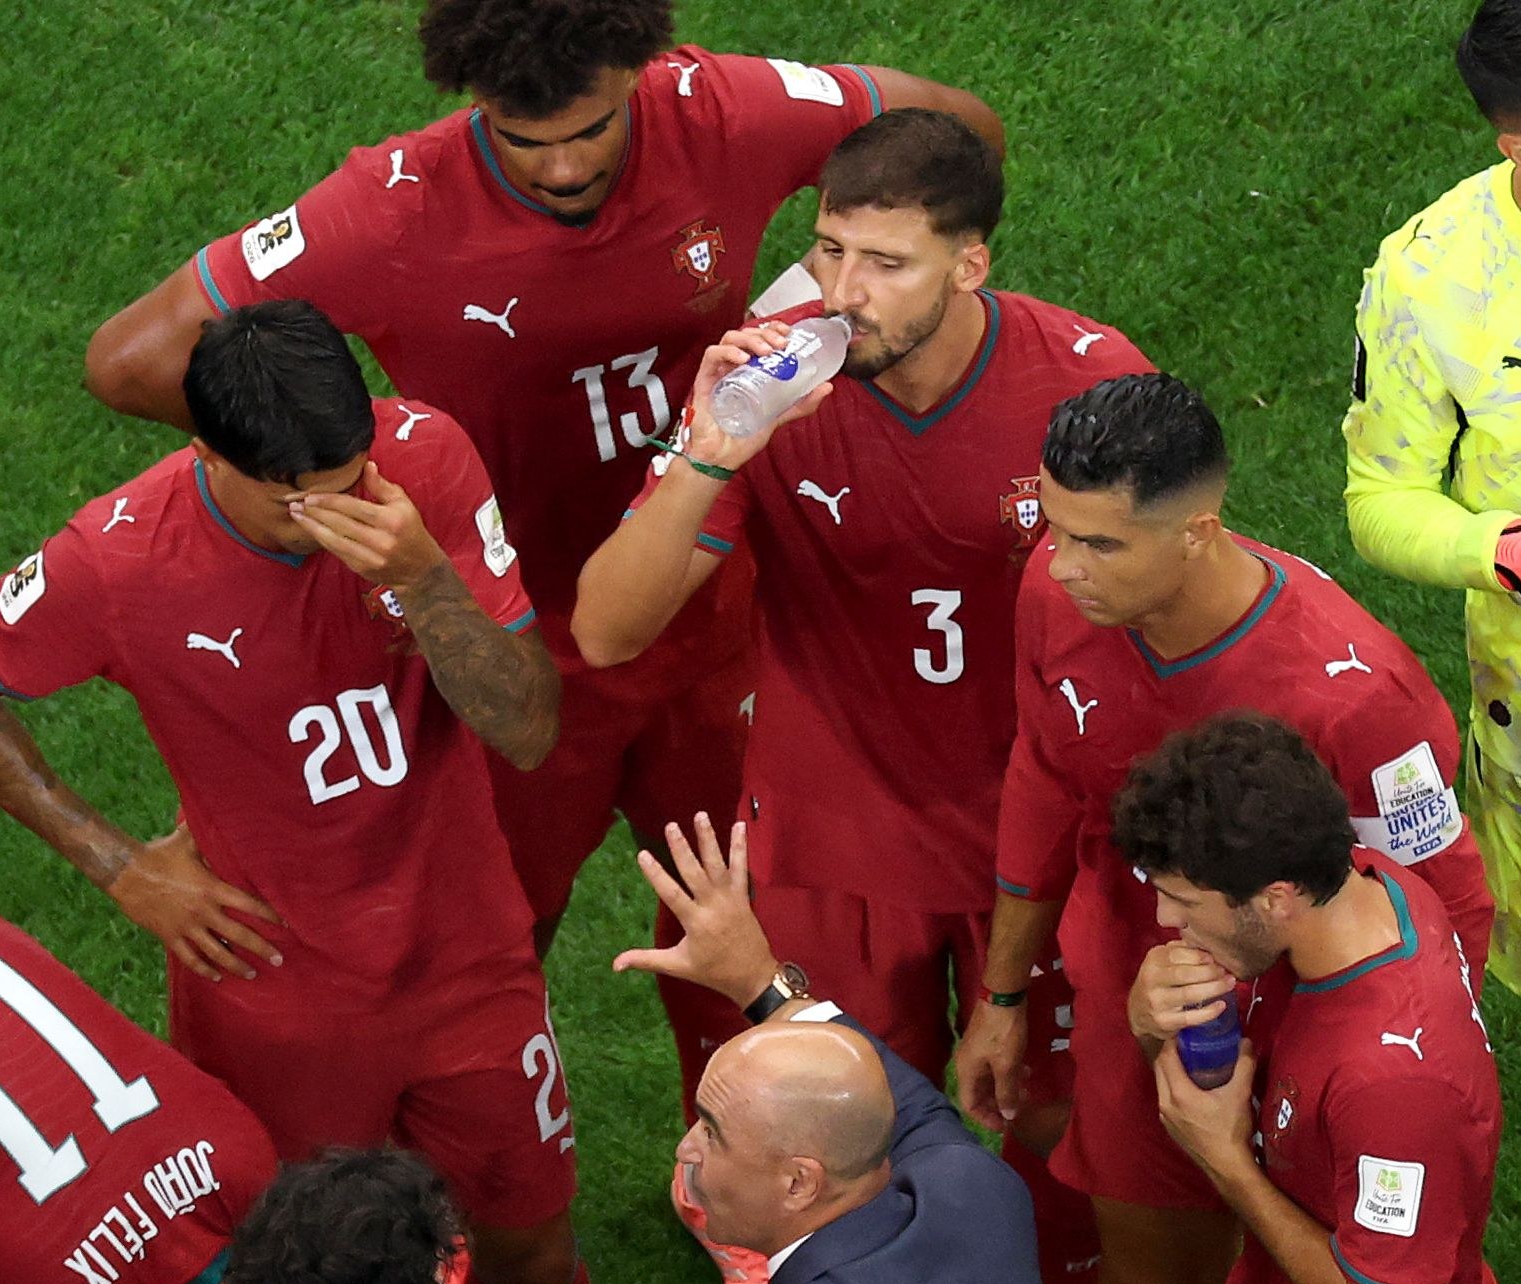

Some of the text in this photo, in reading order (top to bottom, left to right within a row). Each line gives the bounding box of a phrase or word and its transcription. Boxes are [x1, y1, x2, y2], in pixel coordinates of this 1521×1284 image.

[572, 346, 671, 462] 13
[911, 588, 964, 684] 3
[287, 683, 409, 806] 20
[1387, 795, 1447, 836] UNITES
[1387, 834, 1414, 852] the
[1415, 805, 1453, 841] World
[1390, 786, 1434, 809] EDUCATION
[142, 1139, 221, 1216] JOÃO
[1365, 1198, 1406, 1218] EDUCATION
